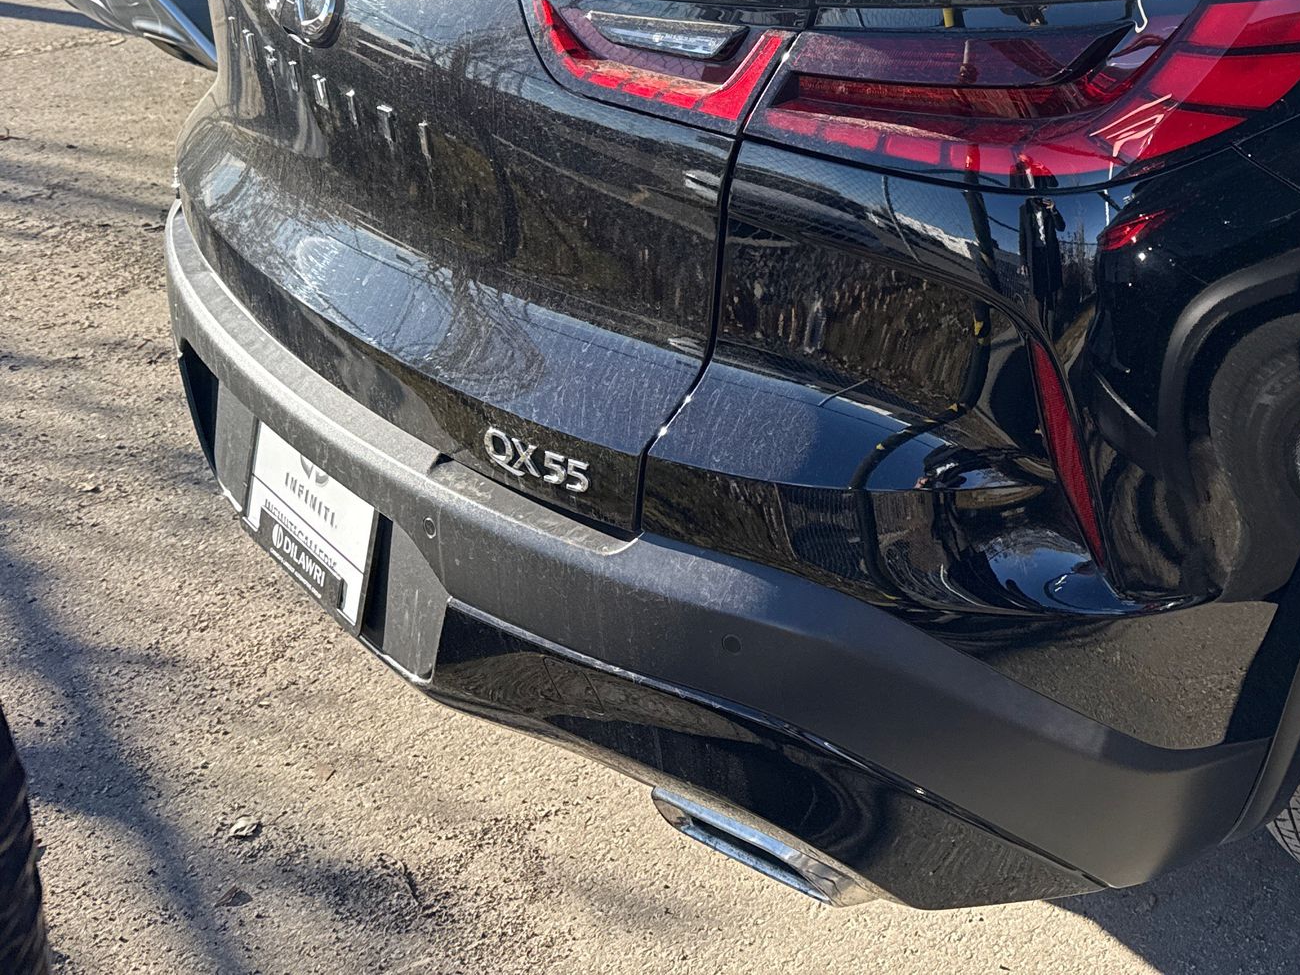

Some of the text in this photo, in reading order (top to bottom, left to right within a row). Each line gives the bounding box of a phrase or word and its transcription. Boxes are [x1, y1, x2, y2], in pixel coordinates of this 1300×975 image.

[484, 426, 590, 493] QX55
[284, 472, 335, 529] INFINITI
[283, 535, 326, 587] DILAWRI
